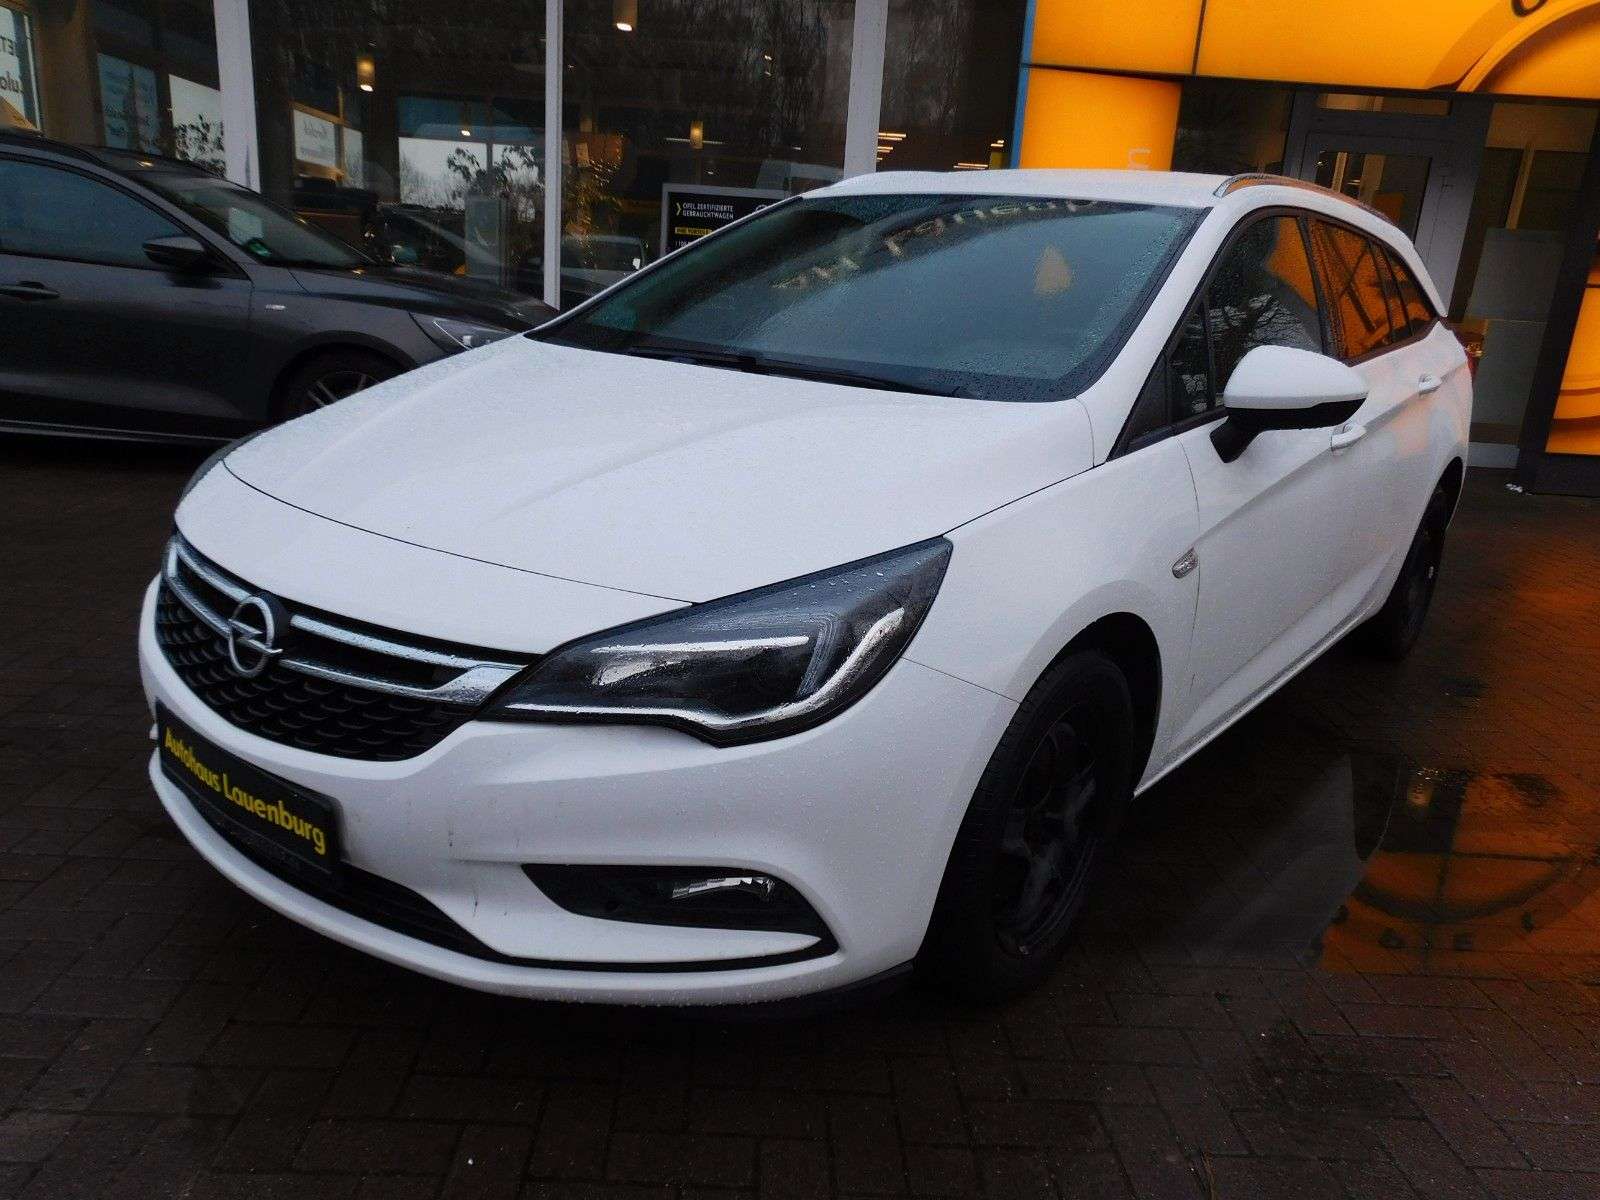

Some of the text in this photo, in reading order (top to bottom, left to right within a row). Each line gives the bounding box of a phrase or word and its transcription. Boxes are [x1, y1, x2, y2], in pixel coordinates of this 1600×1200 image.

[697, 203, 734, 212] ZERTIFIZIERTE
[683, 210, 734, 219] GEBRAUCHTWAGEN
[165, 726, 326, 856] Autohaus Lauenburg
